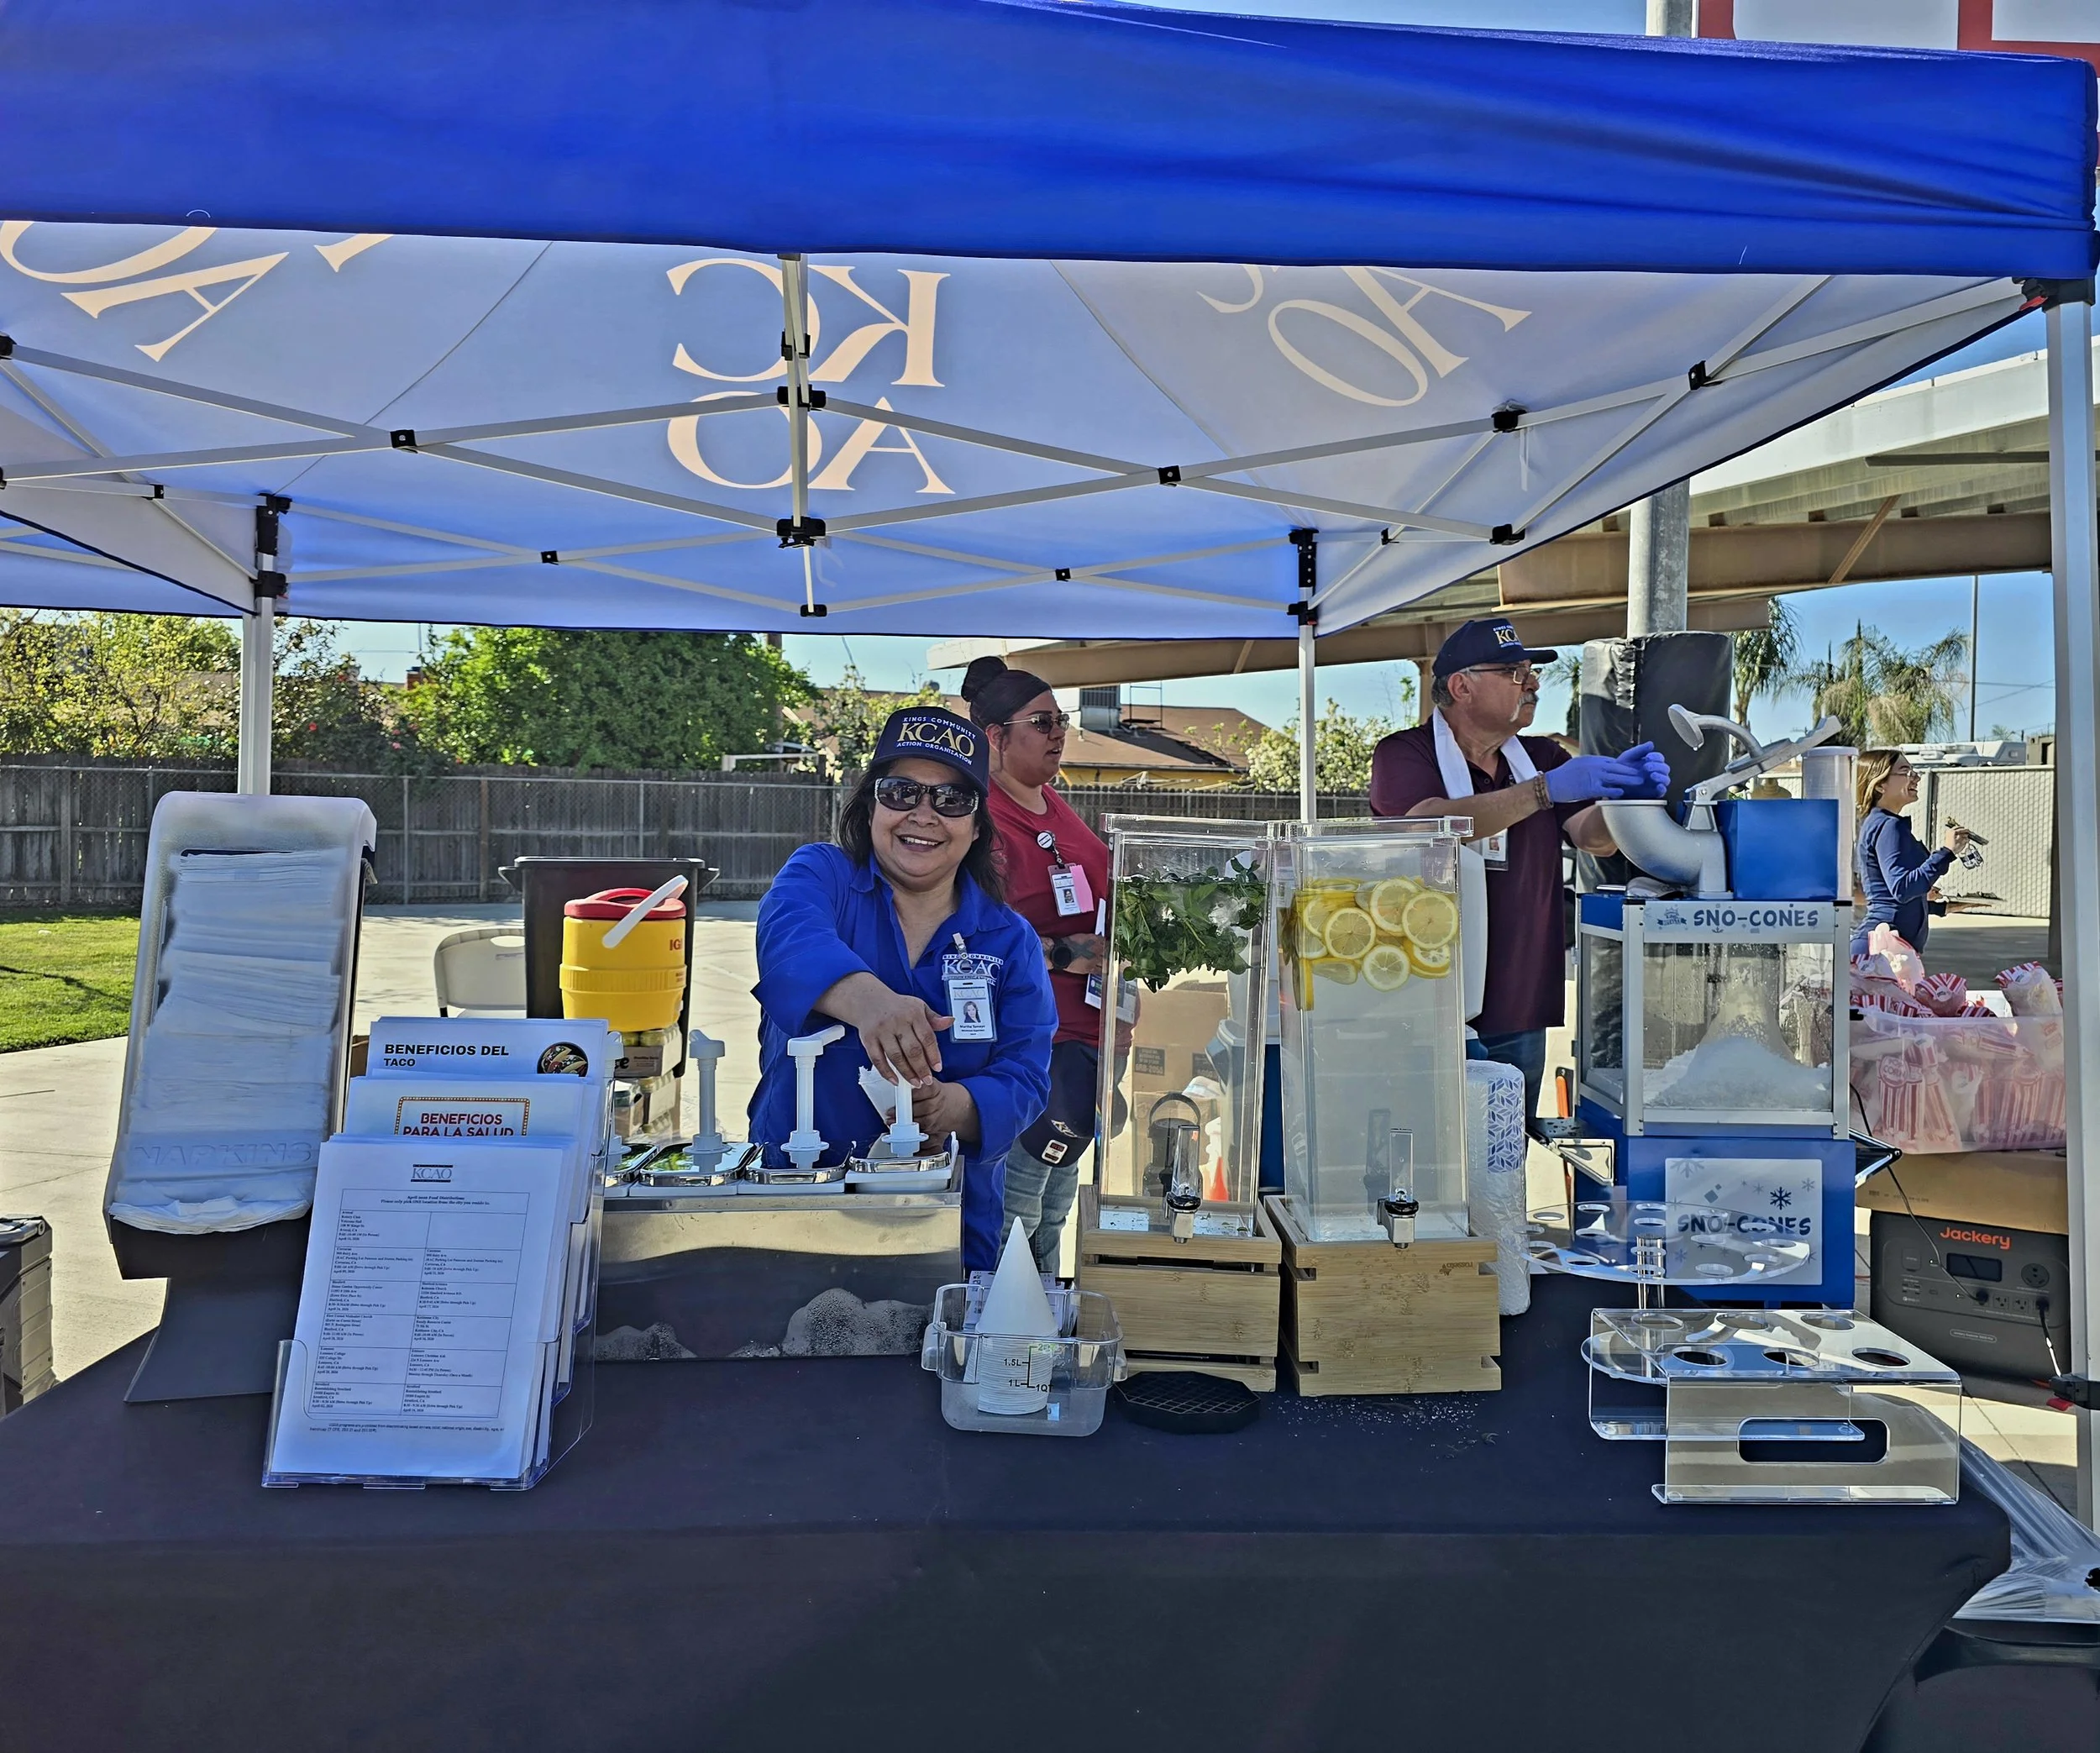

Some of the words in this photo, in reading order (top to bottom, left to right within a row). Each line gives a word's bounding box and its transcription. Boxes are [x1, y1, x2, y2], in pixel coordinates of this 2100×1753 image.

[931, 717, 976, 739] COMMUNITY
[897, 722, 974, 757] KCAO
[925, 743, 973, 765] ORGANIZATION
[1693, 910, 1819, 927] SNO-CONES
[385, 1044, 476, 1056] BENEFICIOS
[480, 1045, 509, 1056] DEL
[383, 1058, 416, 1067] TACO
[421, 1113, 502, 1125] BENEFICIOS
[402, 1126, 439, 1136] PARA
[444, 1126, 464, 1136] LA
[466, 1127, 514, 1136] SALUD
[134, 1142, 312, 1166] NAPKINS
[412, 1167, 452, 1180] KCAO
[1677, 1215, 1811, 1236] SNO-CONES
[1940, 1226, 2011, 1250] Jackery
[1004, 1358, 1021, 1367] 1.5L
